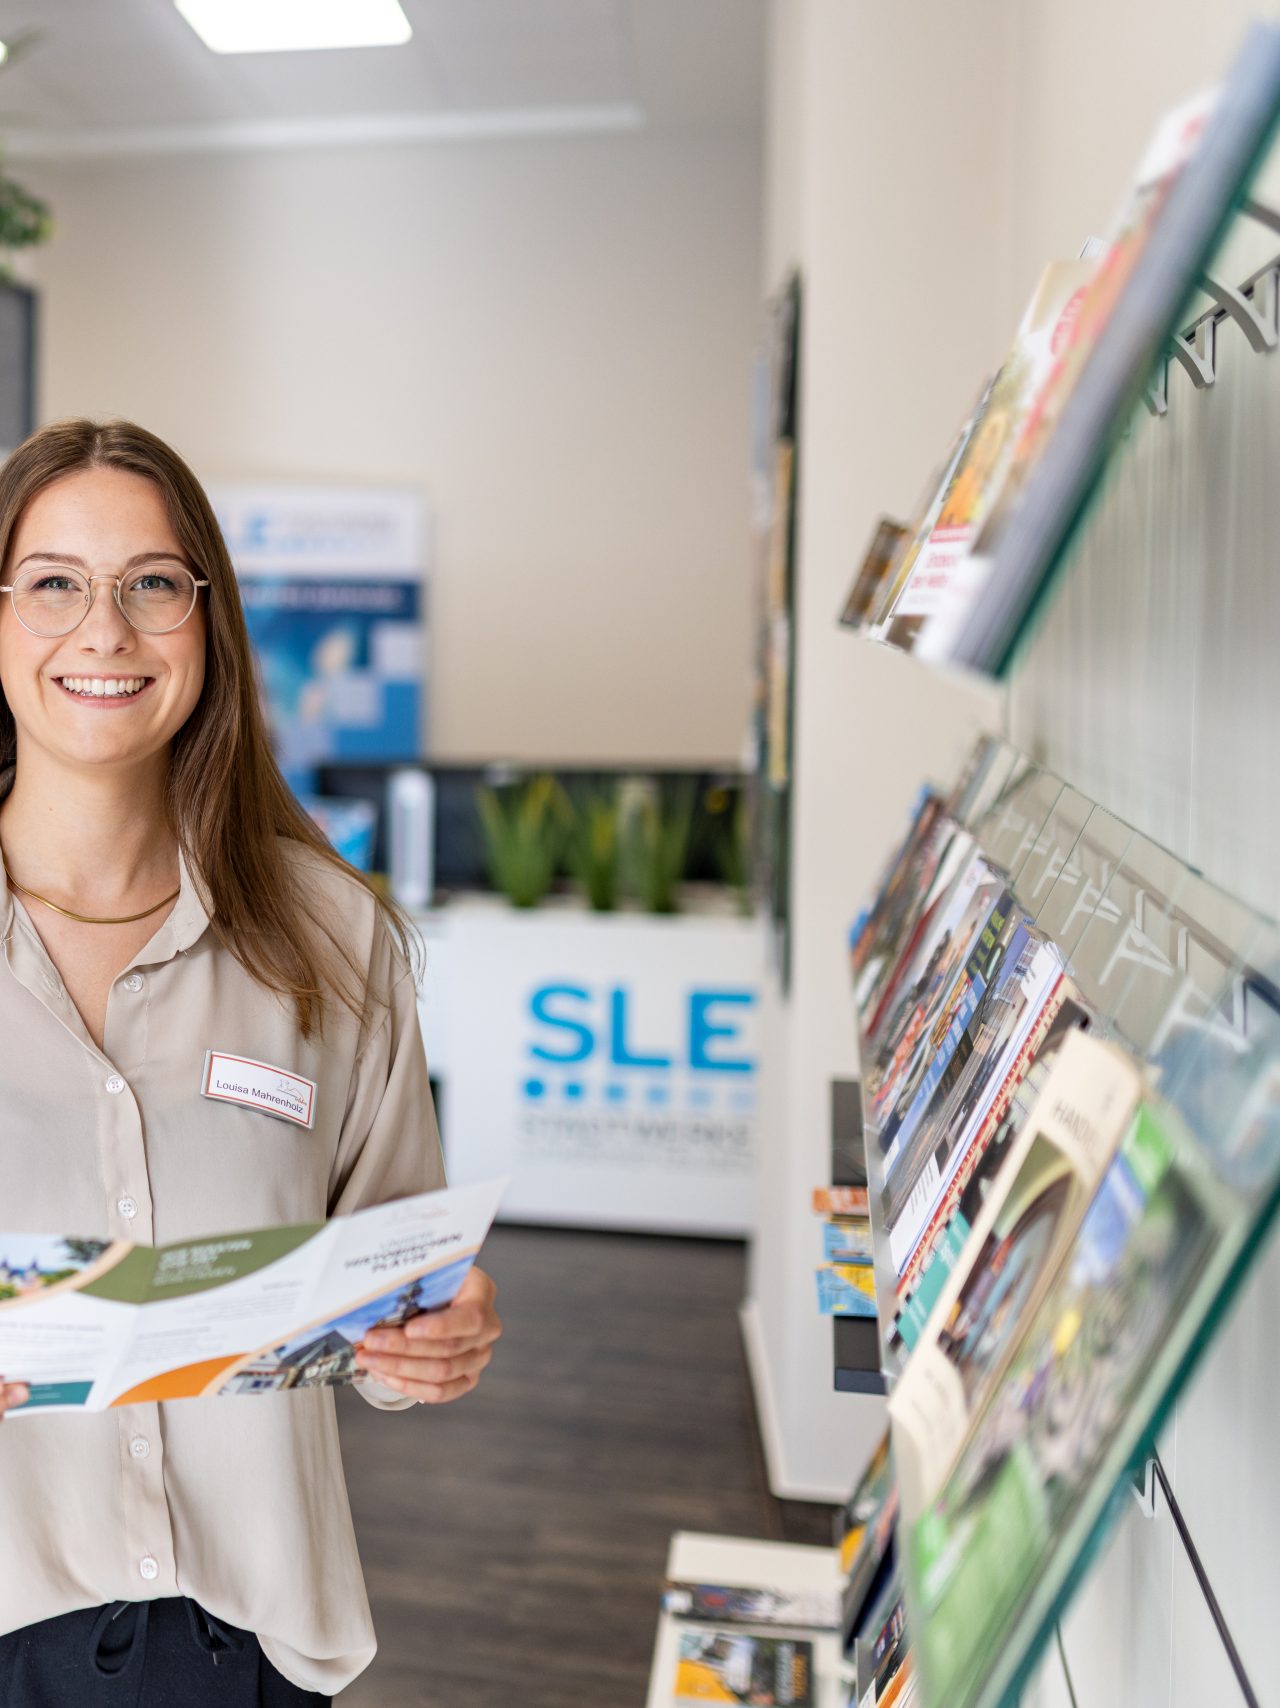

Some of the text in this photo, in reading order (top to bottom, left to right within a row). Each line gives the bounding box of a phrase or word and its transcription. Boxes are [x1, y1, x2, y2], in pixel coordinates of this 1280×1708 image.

[527, 982, 756, 1074] SLE
[216, 1080, 249, 1095] Louisa
[251, 1087, 304, 1114] Mahrenholz
